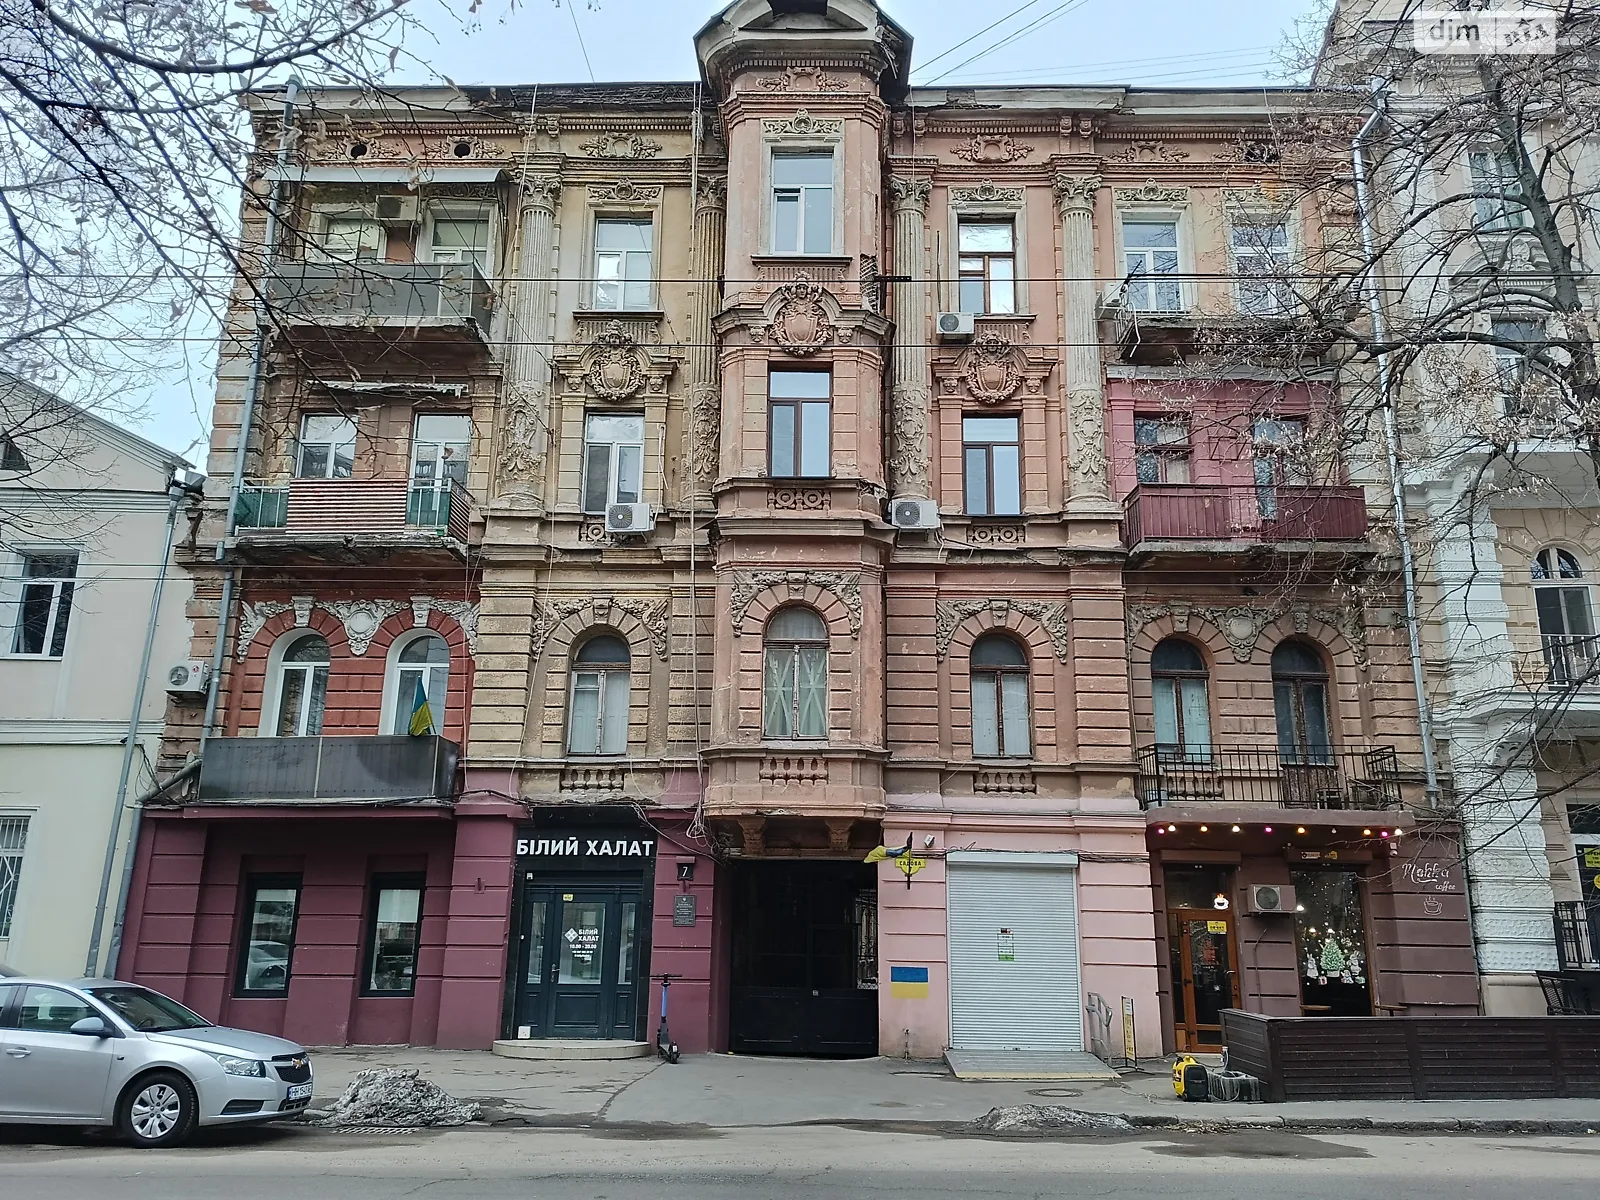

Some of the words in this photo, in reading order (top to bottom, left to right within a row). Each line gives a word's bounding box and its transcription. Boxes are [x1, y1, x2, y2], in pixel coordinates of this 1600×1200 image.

[516, 837, 578, 855] БІЛИЙ
[585, 840, 654, 856] ХАЛАТ
[682, 866, 688, 877] 7
[1435, 881, 1456, 891] coffee
